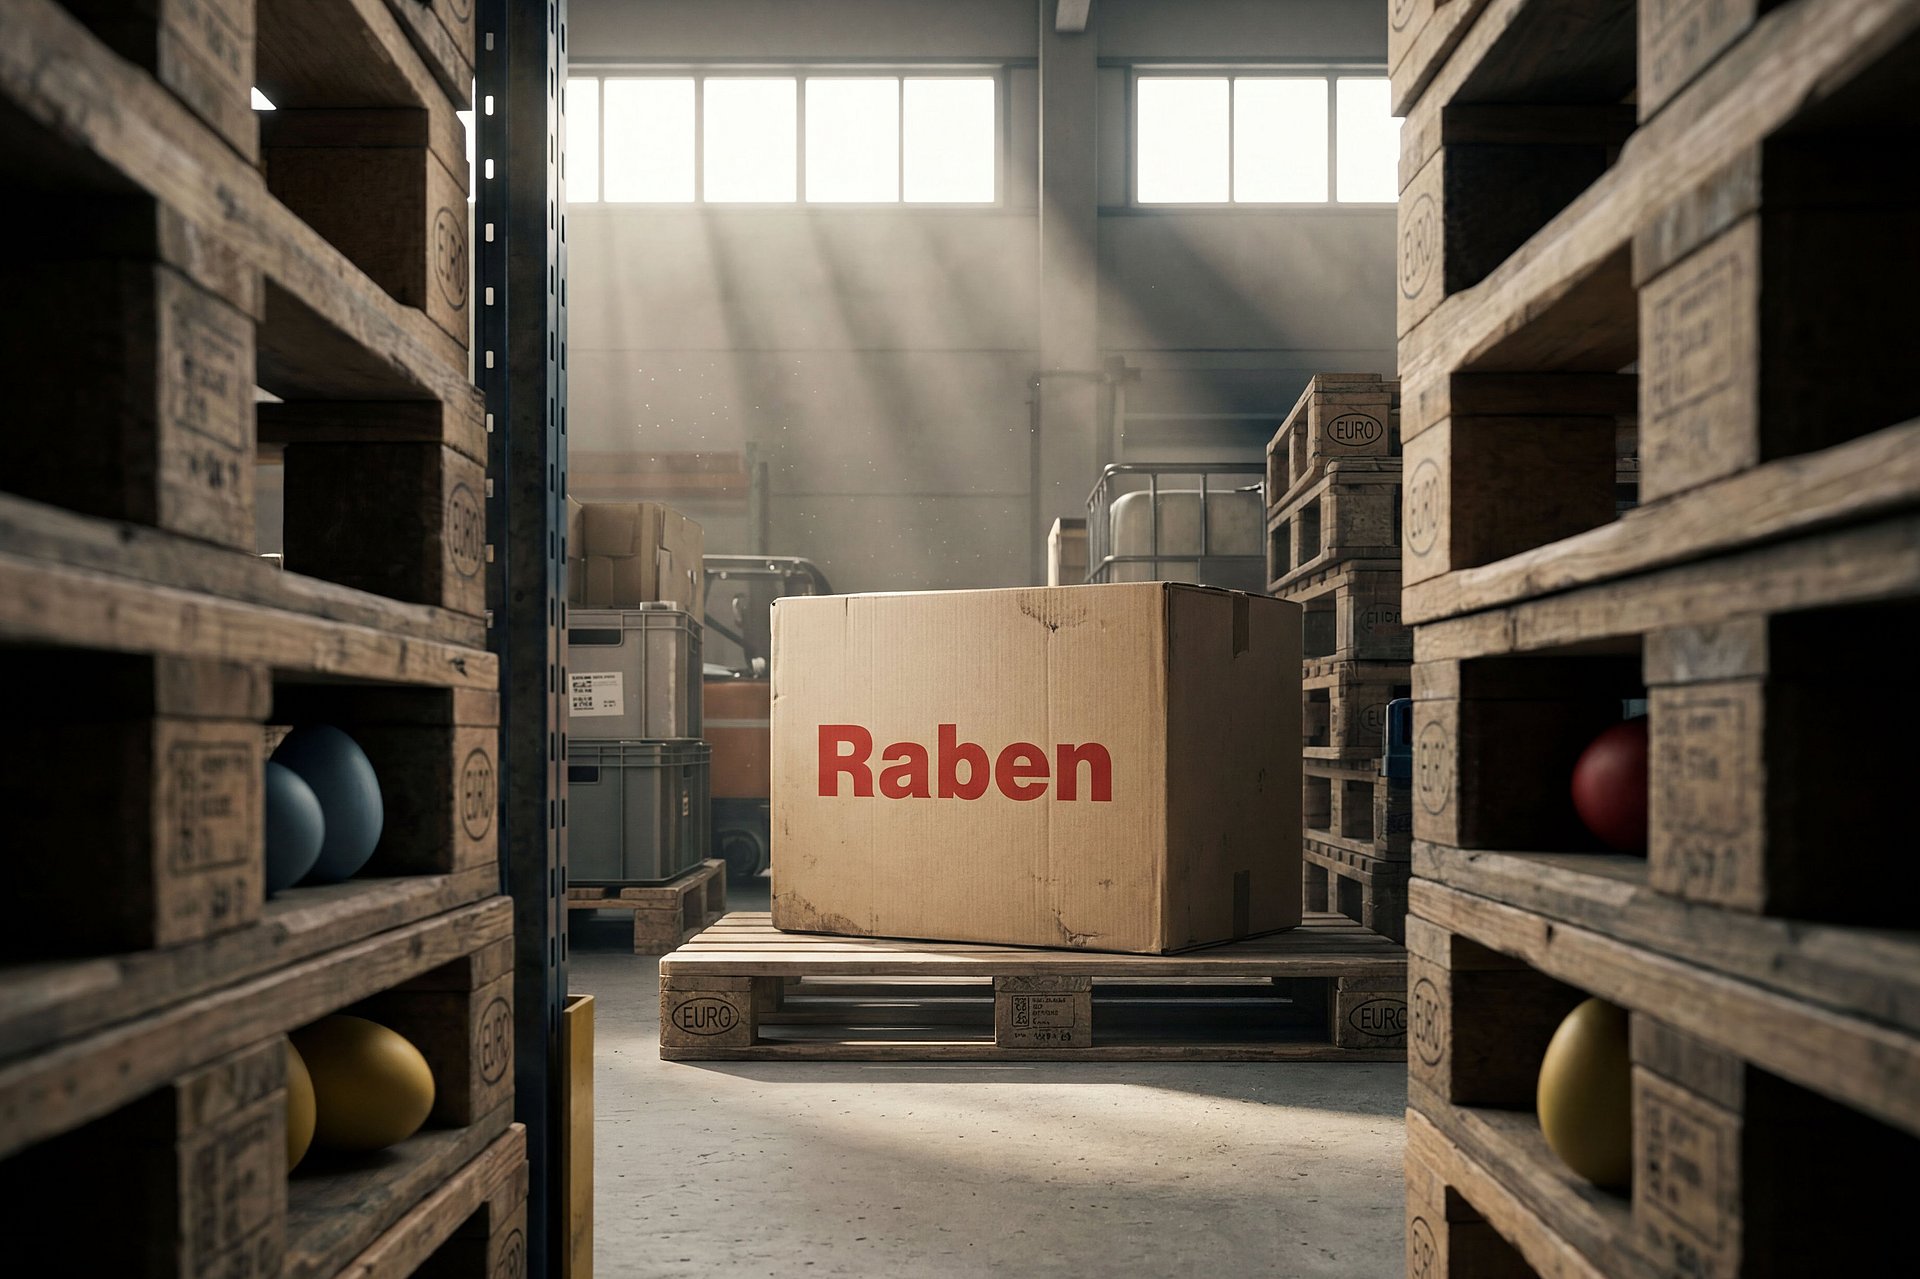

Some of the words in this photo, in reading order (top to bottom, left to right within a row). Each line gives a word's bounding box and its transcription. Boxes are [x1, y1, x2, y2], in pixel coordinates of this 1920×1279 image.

[1337, 421, 1373, 439] EURO
[818, 723, 1112, 801] Raben
[683, 1005, 731, 1028] EURO
